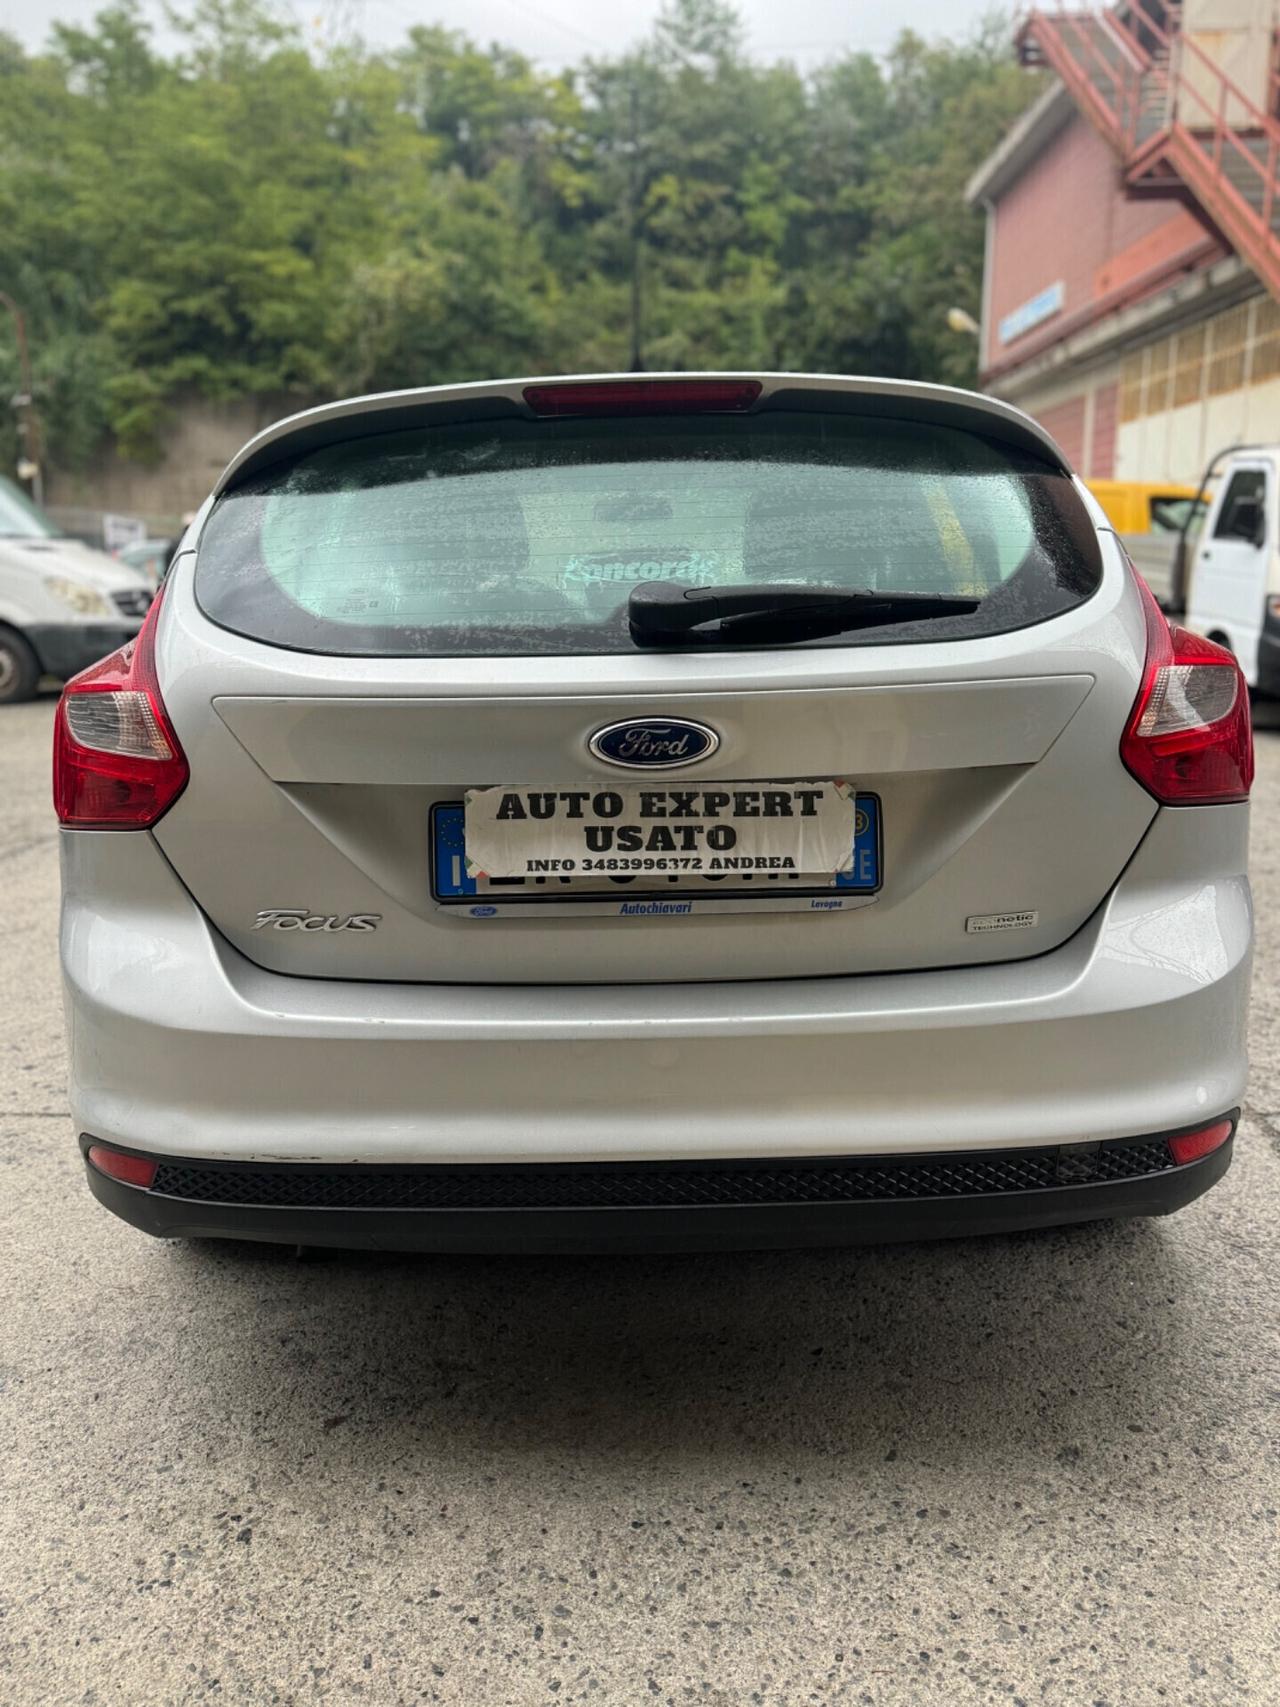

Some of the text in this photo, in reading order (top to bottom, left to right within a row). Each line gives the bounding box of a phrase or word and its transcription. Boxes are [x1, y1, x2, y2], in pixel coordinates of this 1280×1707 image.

[619, 727, 690, 757] Ford
[496, 790, 824, 820] AUTO EXPERT
[584, 825, 737, 853] USATO
[527, 857, 796, 872] INFO 3483996372 ANDREA
[620, 901, 693, 915] Autochiavari
